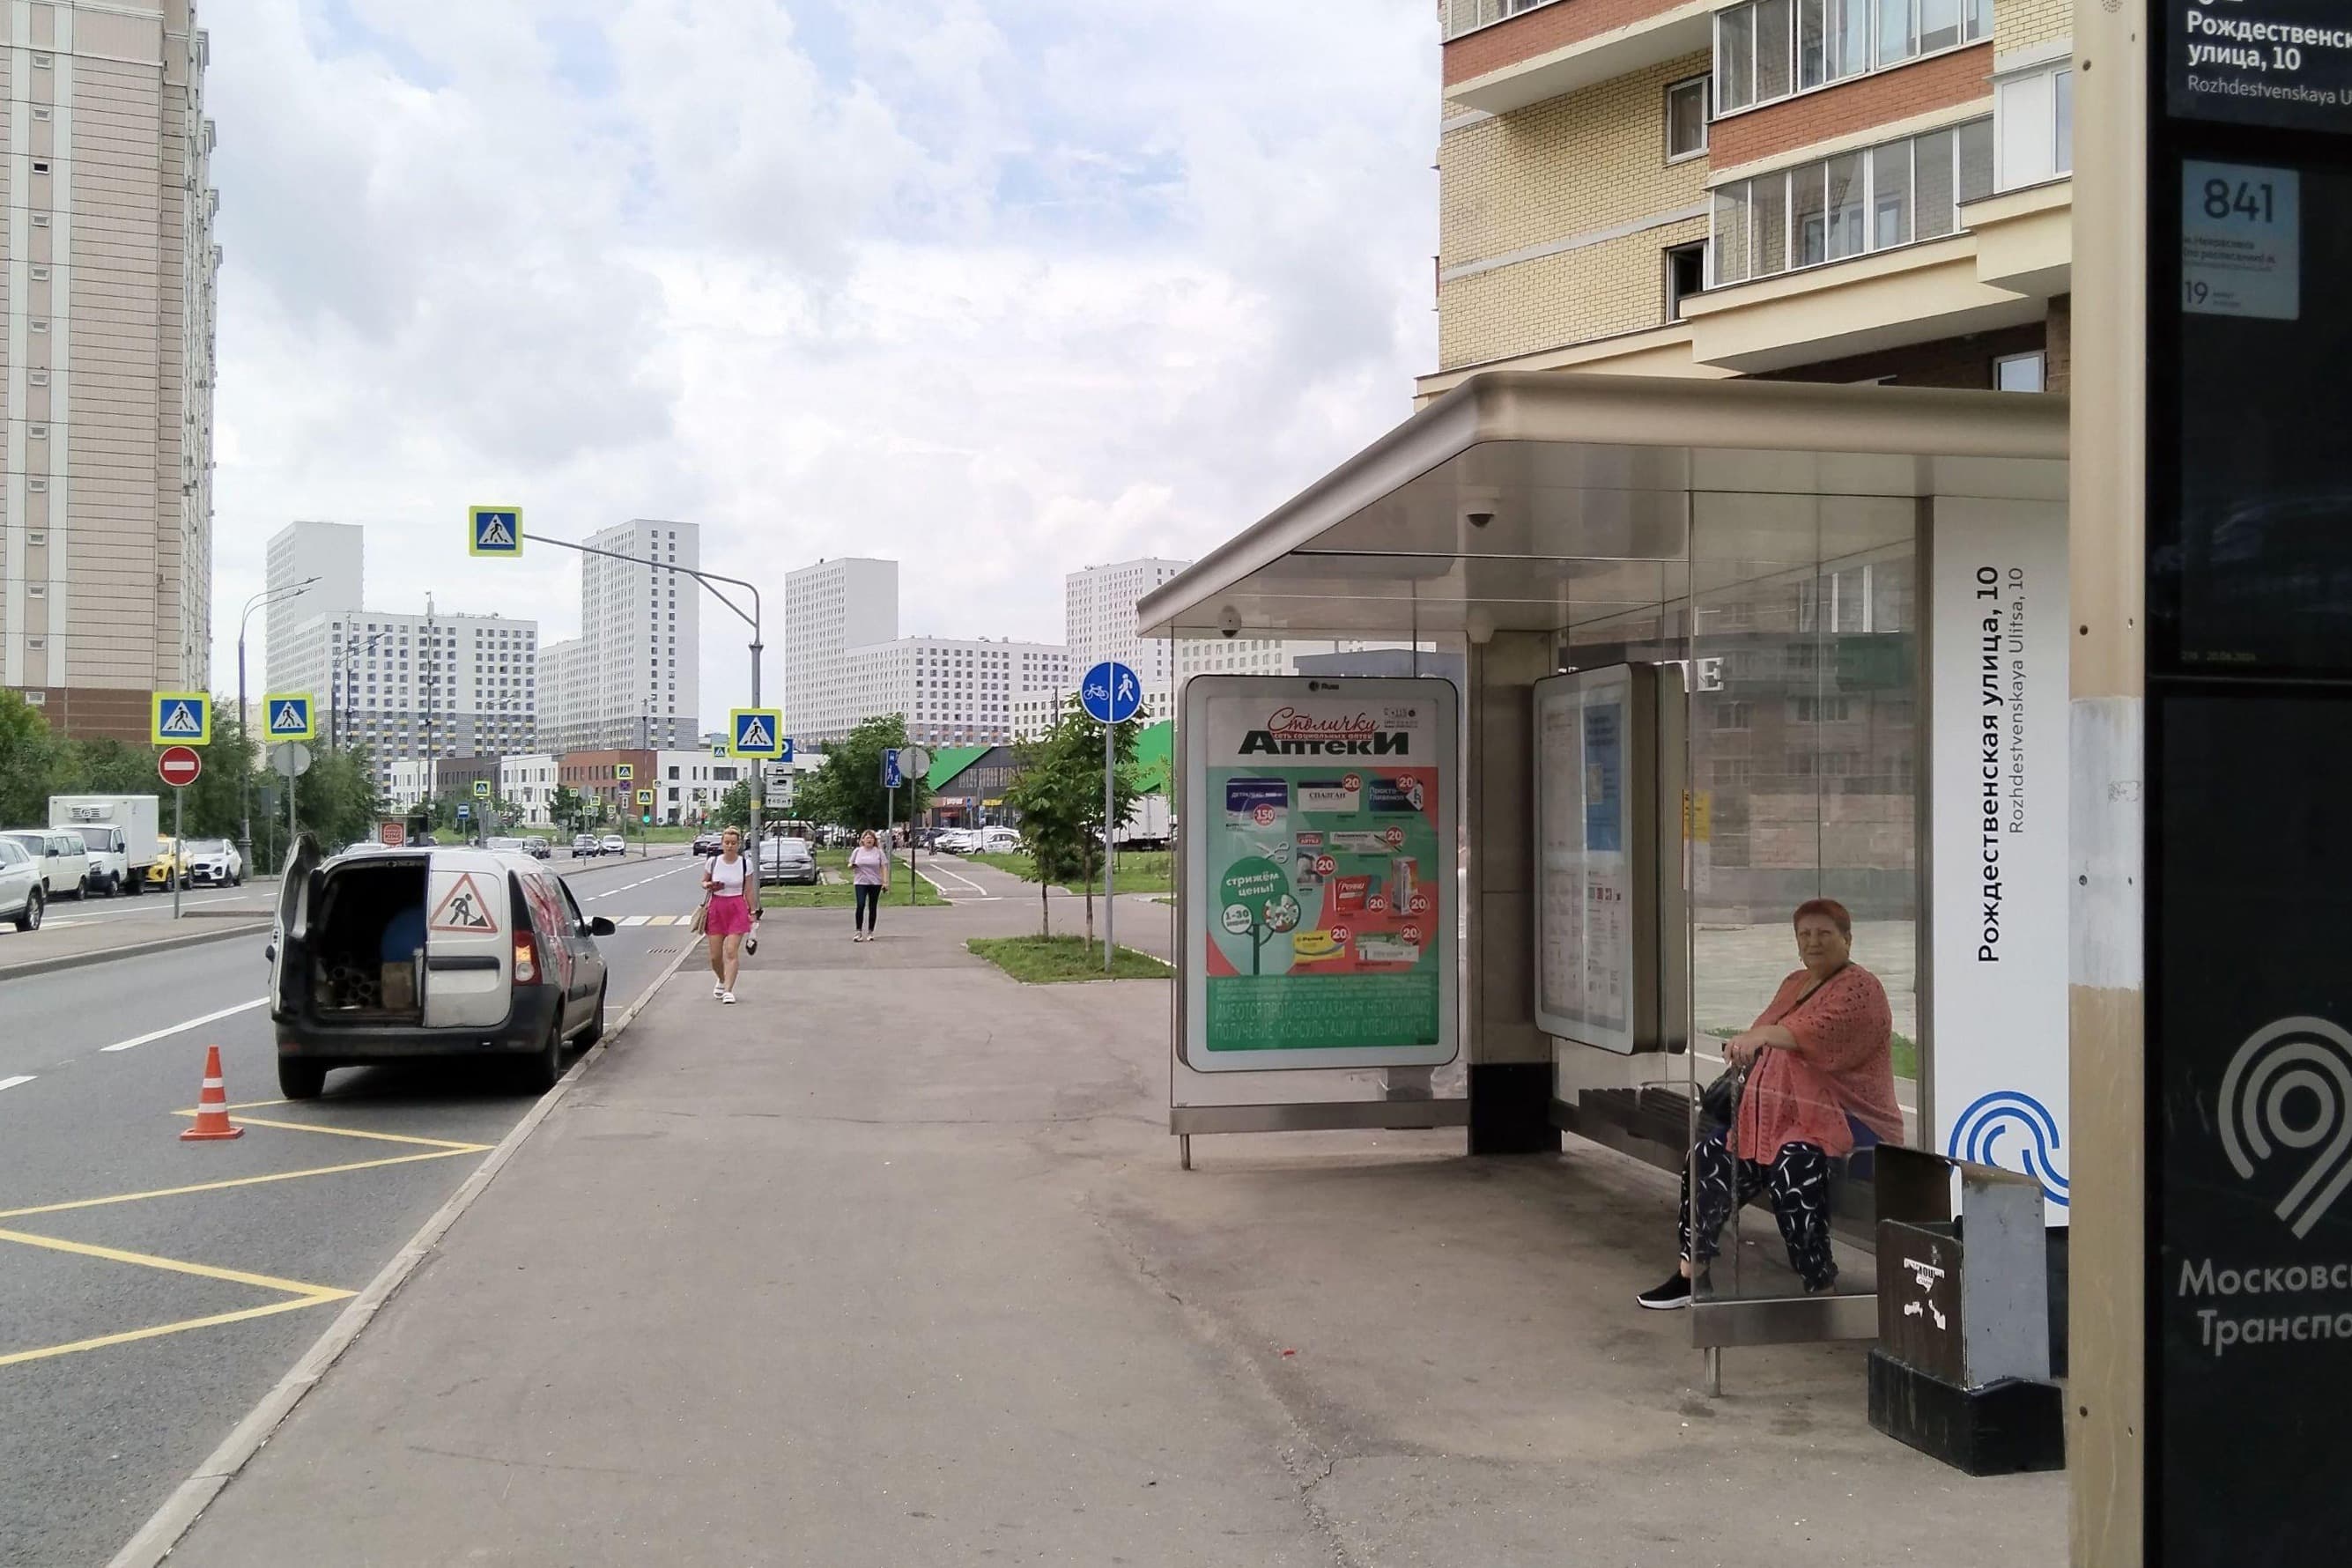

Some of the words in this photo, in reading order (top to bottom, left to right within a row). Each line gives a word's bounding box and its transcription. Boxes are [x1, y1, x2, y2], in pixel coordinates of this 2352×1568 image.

[2188, 44, 2267, 71] улица,
[2273, 47, 2301, 70] 10
[2188, 75, 2335, 106] Rozhdestvenskaya
[2204, 179, 2274, 223] 841
[2185, 280, 2208, 304] 19
[1977, 566, 1998, 600] 10
[2008, 568, 2023, 589] 10
[2008, 595, 2025, 654] Ulitsa,
[1982, 610, 2004, 706] улица,
[1268, 706, 1381, 733] Столички
[2009, 660, 2027, 833] Rozhdestvenskaya
[1345, 778, 1360, 788] 20
[1399, 778, 1413, 788] 20
[1256, 810, 1274, 820] 150
[1387, 831, 1402, 840] 20
[1978, 715, 2001, 962] Рождественская
[1318, 861, 1334, 870] 20
[1226, 872, 1280, 886] стрижём
[1238, 884, 1275, 897] цены!
[1370, 899, 1384, 909] 20
[1411, 899, 1425, 908] 20
[1332, 928, 1347, 938] 20
[1403, 928, 1417, 938] 20
[2178, 1258, 2352, 1297] Московс
